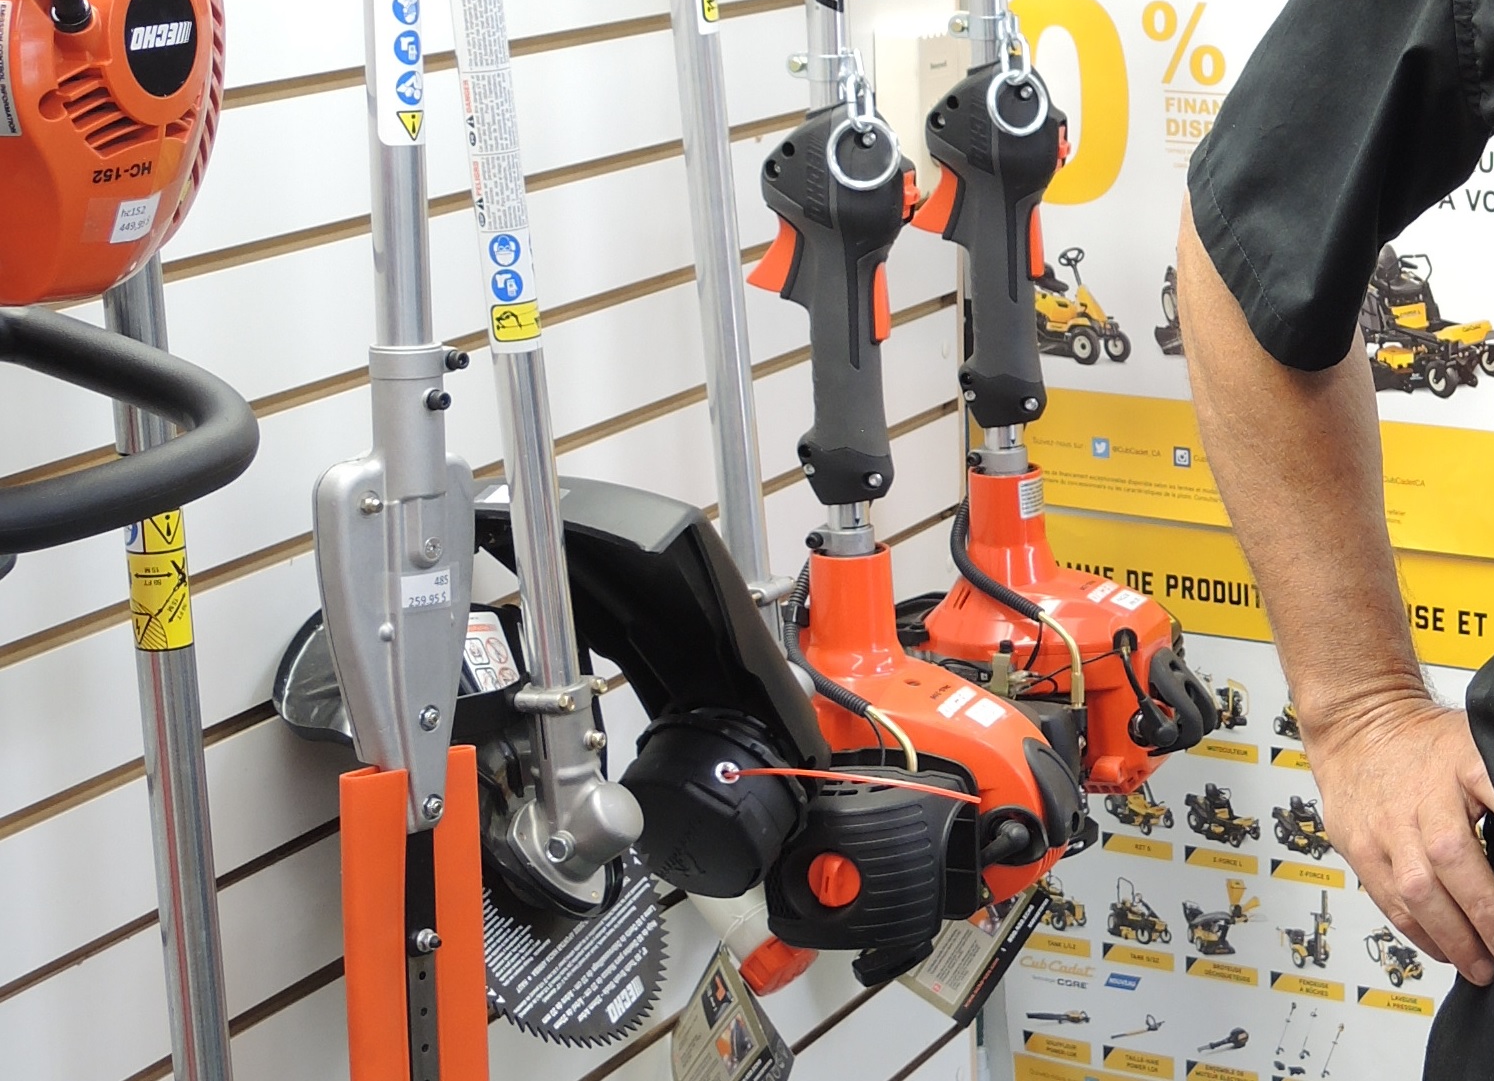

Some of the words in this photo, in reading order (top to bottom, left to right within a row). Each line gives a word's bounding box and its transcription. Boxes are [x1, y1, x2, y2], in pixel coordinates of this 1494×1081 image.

[130, 21, 185, 51] ECHO
[92, 160, 152, 184] HC-152
[434, 574, 449, 586] 485
[1126, 569, 1154, 596] DE
[1458, 610, 1488, 638] ET
[1206, 745, 1248, 757] MOTOCULTEUR
[1048, 959, 1095, 978] Cadet
[1057, 978, 1088, 989] CORE
[606, 975, 646, 1024] ECHO
